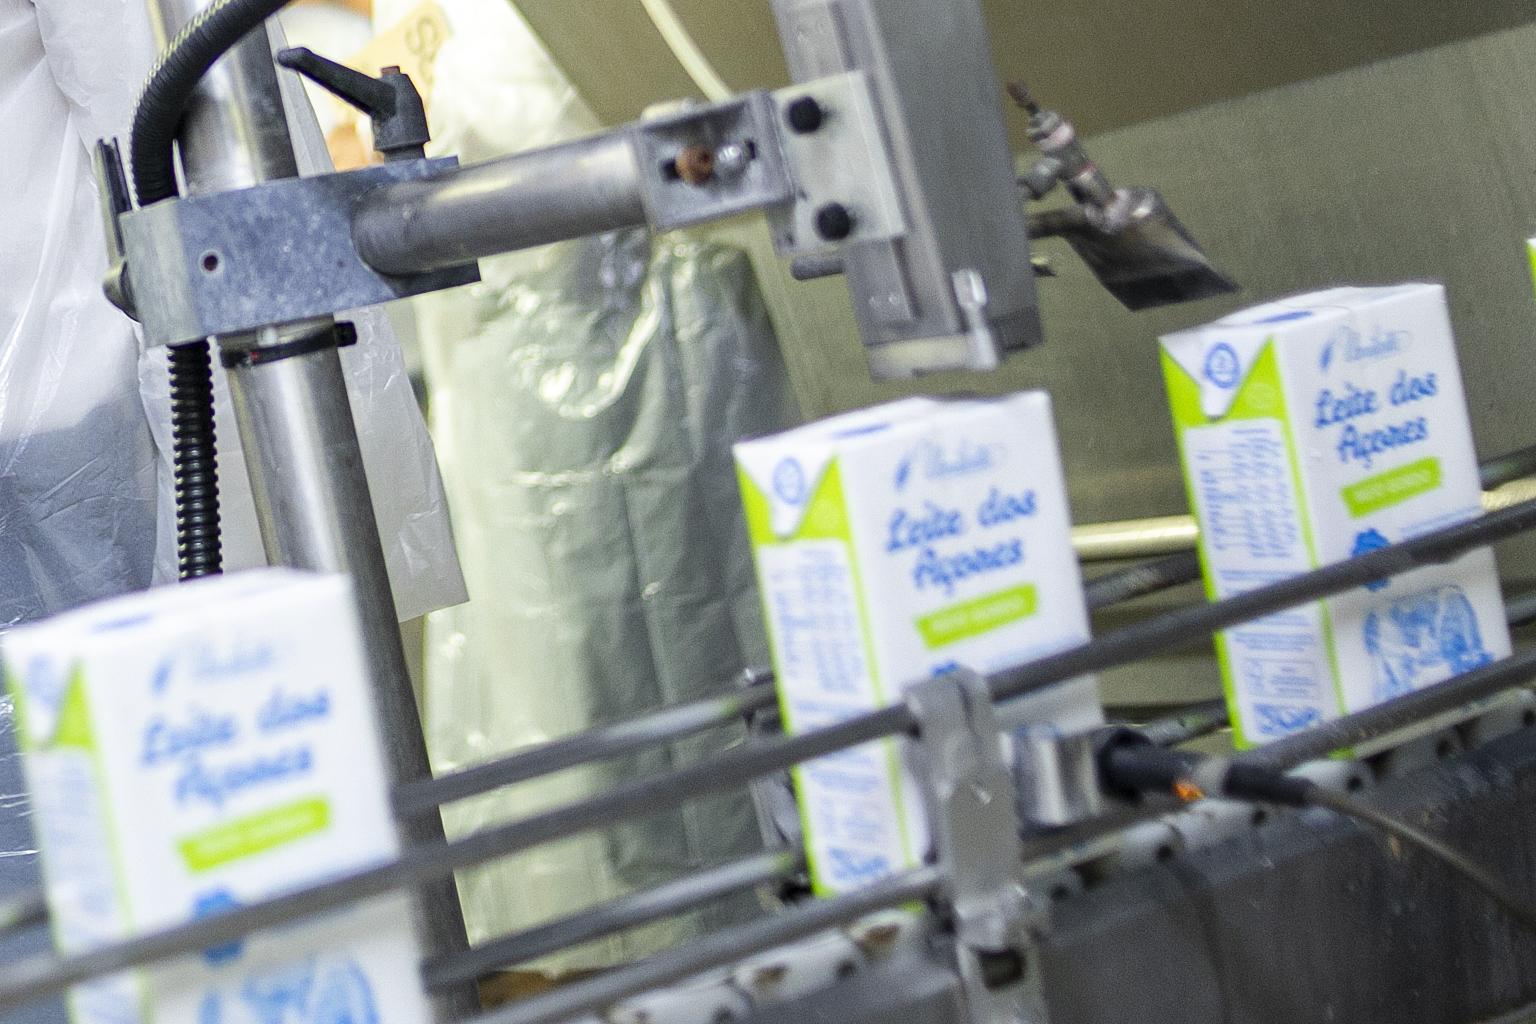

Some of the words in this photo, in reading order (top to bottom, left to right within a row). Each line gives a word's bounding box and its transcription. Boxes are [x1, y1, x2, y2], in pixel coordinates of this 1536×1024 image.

[1315, 381, 1378, 426] Leite
[1390, 369, 1437, 406] dos
[1337, 416, 1429, 468] Açores
[885, 500, 964, 553] Leite
[912, 537, 1025, 596] Açores
